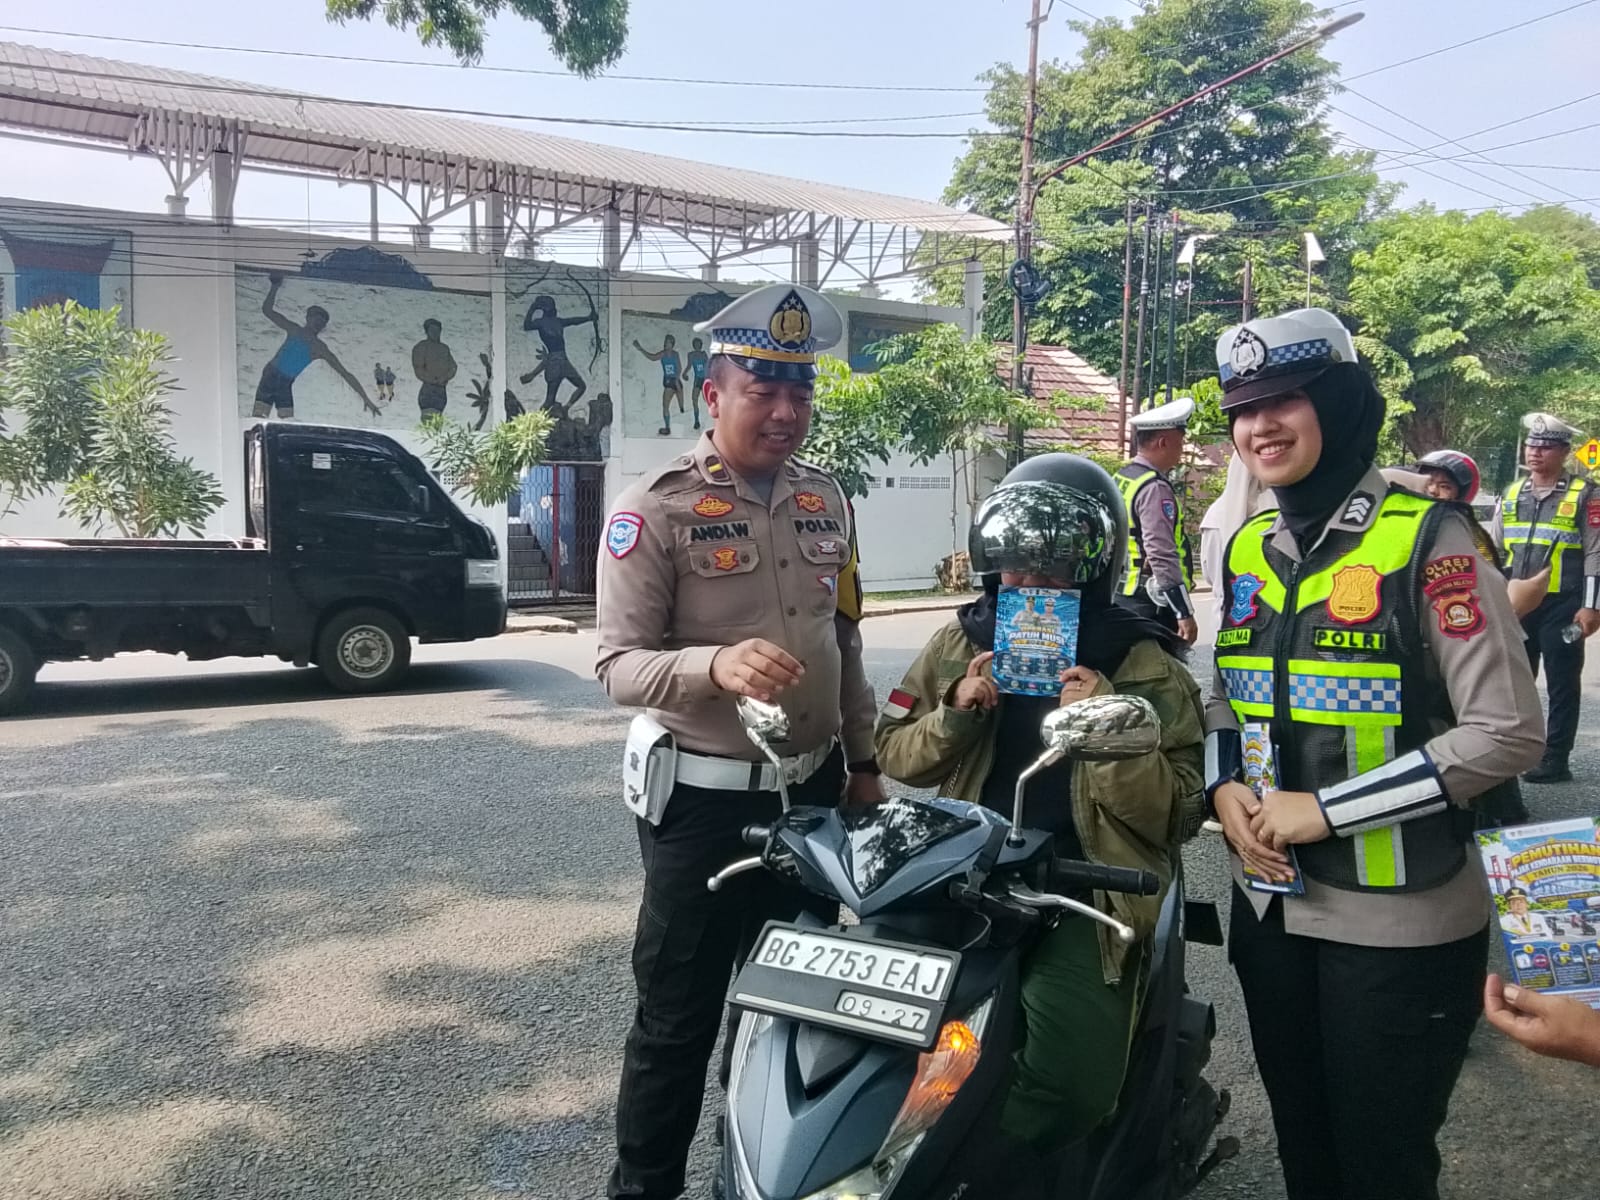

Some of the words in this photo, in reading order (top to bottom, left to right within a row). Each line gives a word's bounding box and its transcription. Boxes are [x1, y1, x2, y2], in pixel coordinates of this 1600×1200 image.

[690, 522, 749, 542] ANDI.W
[794, 519, 841, 534] POLRI
[1425, 558, 1470, 576] OLRES
[1316, 630, 1384, 649] POLRI
[1511, 843, 1600, 870] PEMUTIHAN
[762, 937, 800, 967] BG
[804, 945, 877, 981] 2753
[882, 958, 945, 995] EAJ
